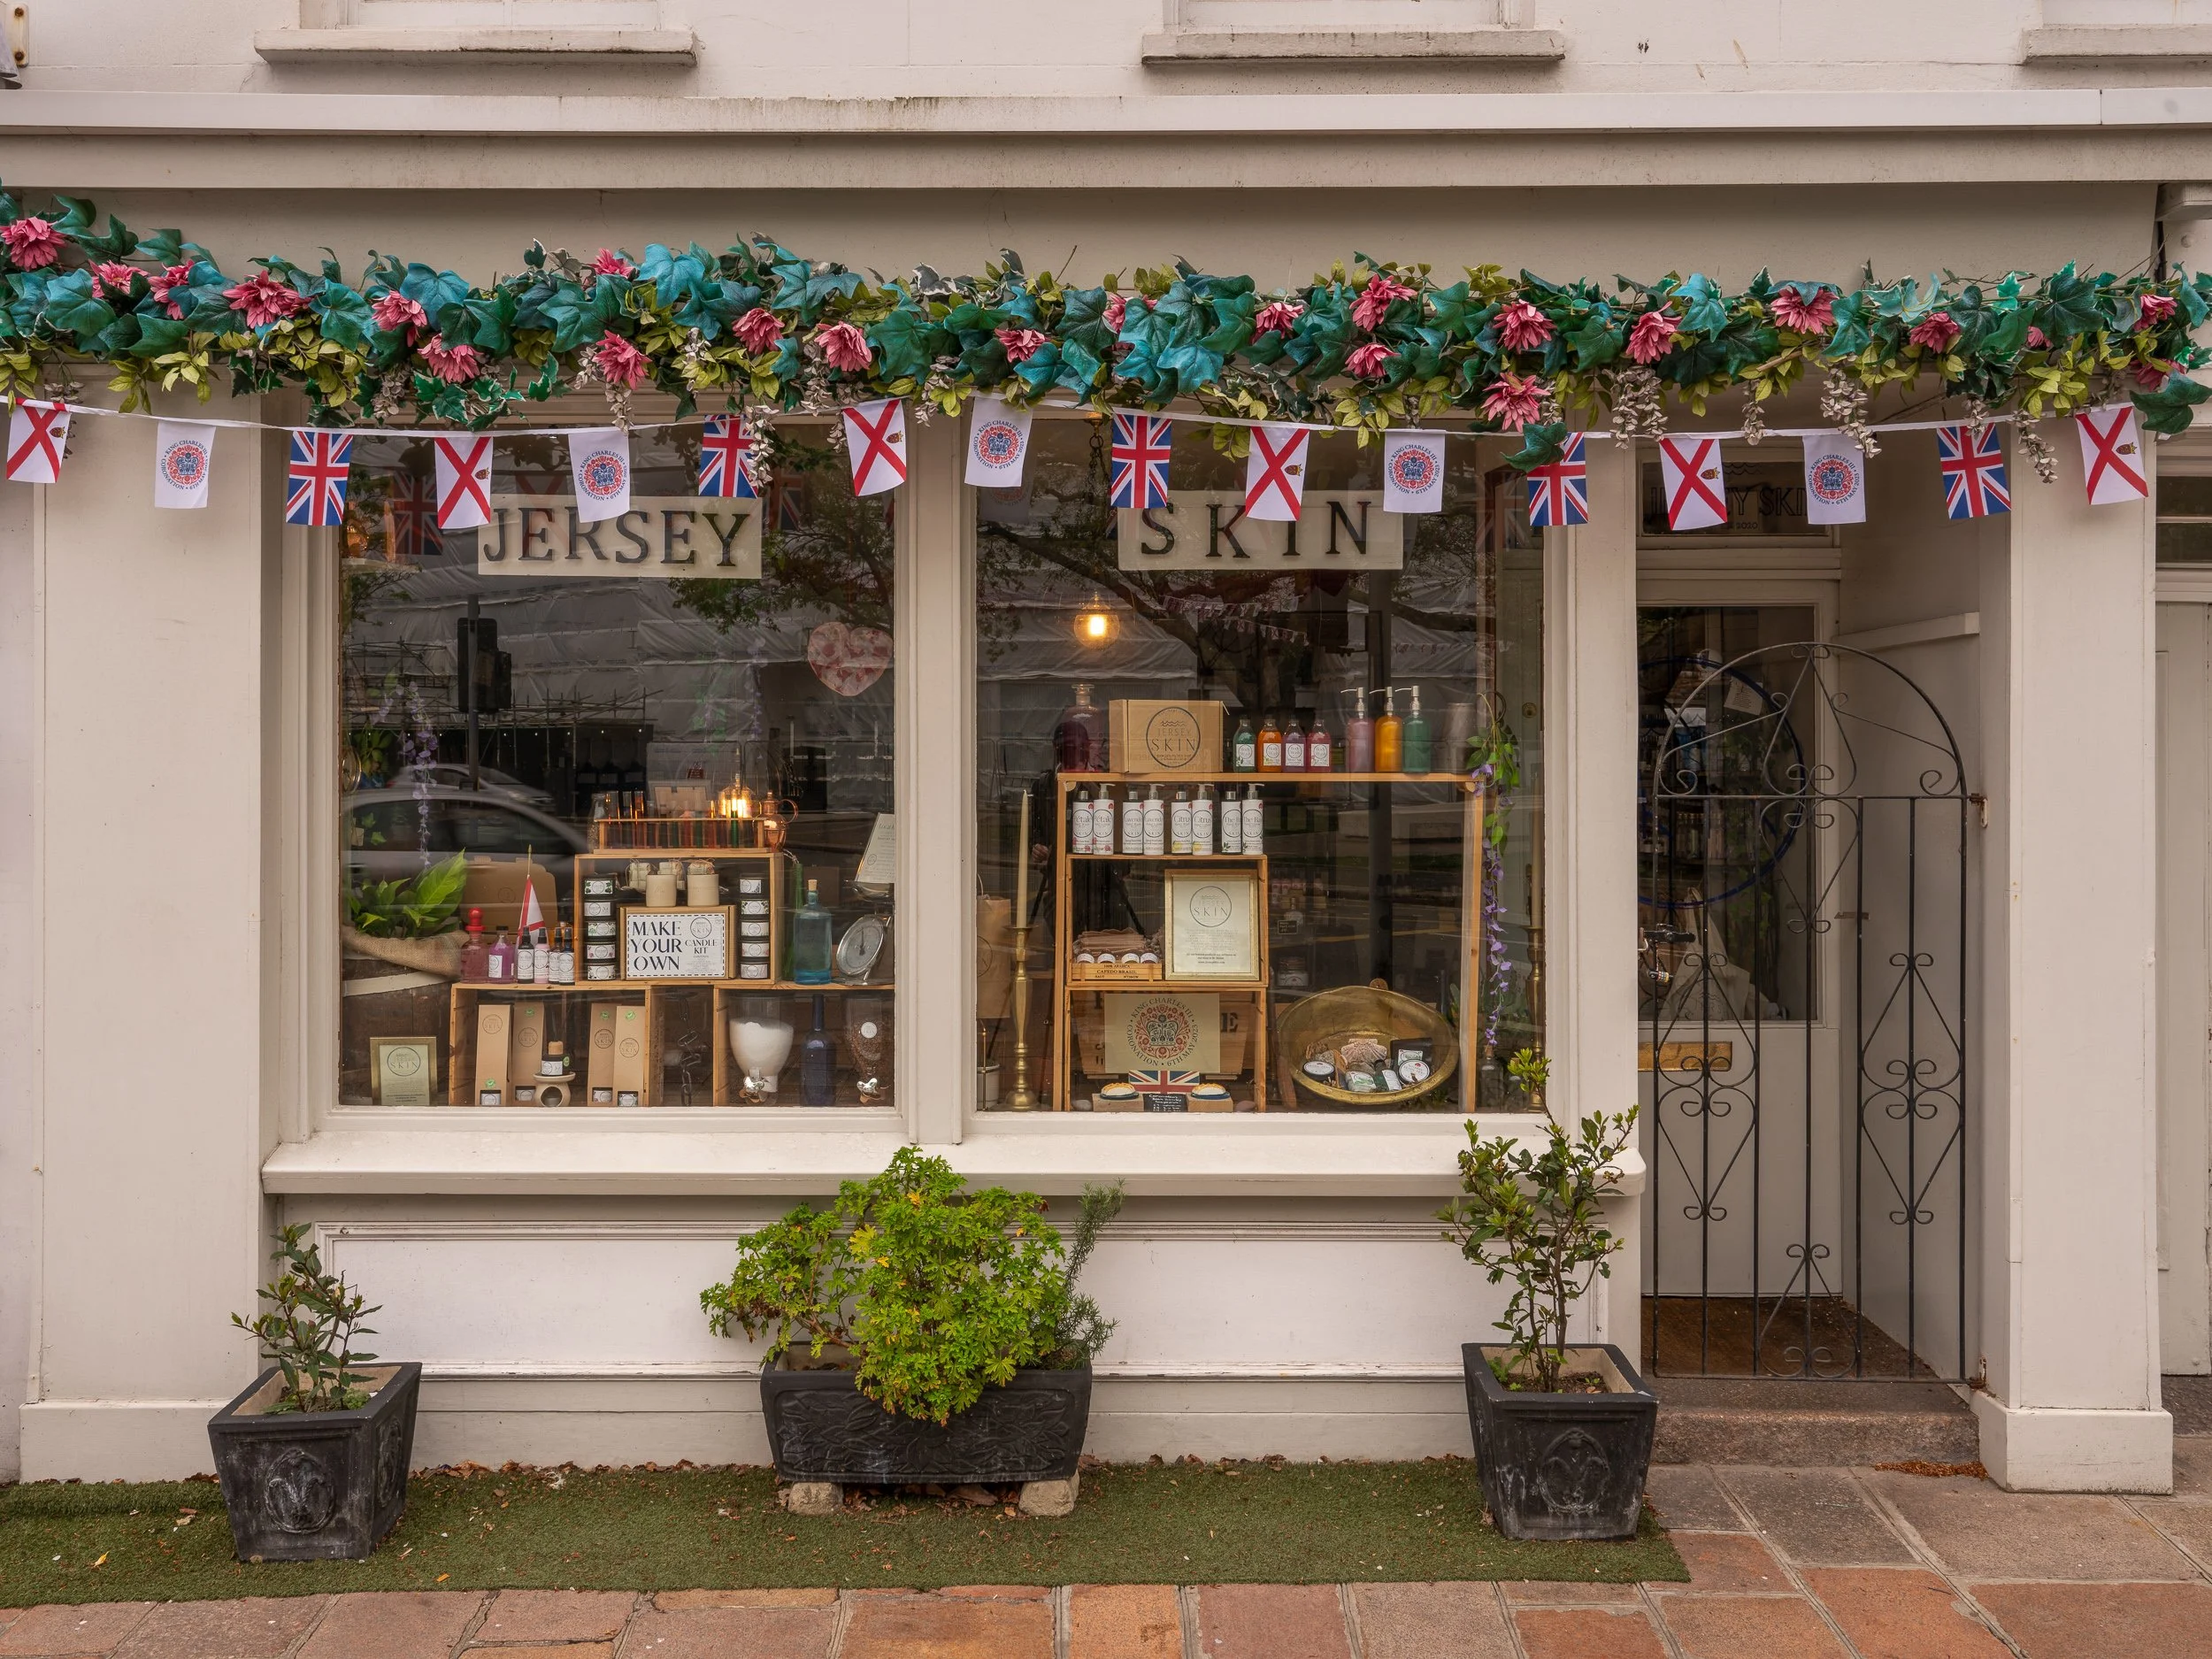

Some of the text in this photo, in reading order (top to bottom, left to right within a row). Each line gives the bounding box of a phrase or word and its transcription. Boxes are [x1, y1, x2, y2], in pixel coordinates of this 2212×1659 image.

[978, 421, 991, 434] KING
[993, 419, 1019, 432] CHARLES
[165, 442, 179, 455] KING
[180, 440, 204, 449] CHARLES
[973, 436, 993, 469] CORONATION
[1392, 447, 1405, 459] KING
[1405, 444, 1432, 455] CHARLES
[580, 455, 592, 469] KING
[1010, 453, 1020, 465] MAY
[1810, 457, 1823, 471] KING
[1823, 454, 1850, 465] CHARLES
[161, 458, 185, 490] CORONATION
[1388, 462, 1410, 494] CORONATION
[578, 473, 605, 501] CORONATION
[1427, 478, 1437, 489] MAY
[1809, 474, 1831, 505] CORONATION
[1847, 487, 1858, 499] MAY
[1759, 488, 1807, 516] SKI
[483, 506, 750, 567] JERSEY
[1141, 501, 1371, 558] SKIN
[1158, 727, 1192, 737] JERSEY
[1151, 738, 1195, 752] SKIN
[1194, 907, 1228, 917] SKIN
[632, 921, 681, 936] MAKE
[630, 938, 682, 953] YOUR
[634, 956, 680, 971] OWN
[1131, 997, 1194, 1018] KING CHARLES III
[1126, 1024, 1159, 1067] CORONATION
[1167, 1056, 1184, 1067] 6TH
[1183, 1043, 1195, 1059] MAY
